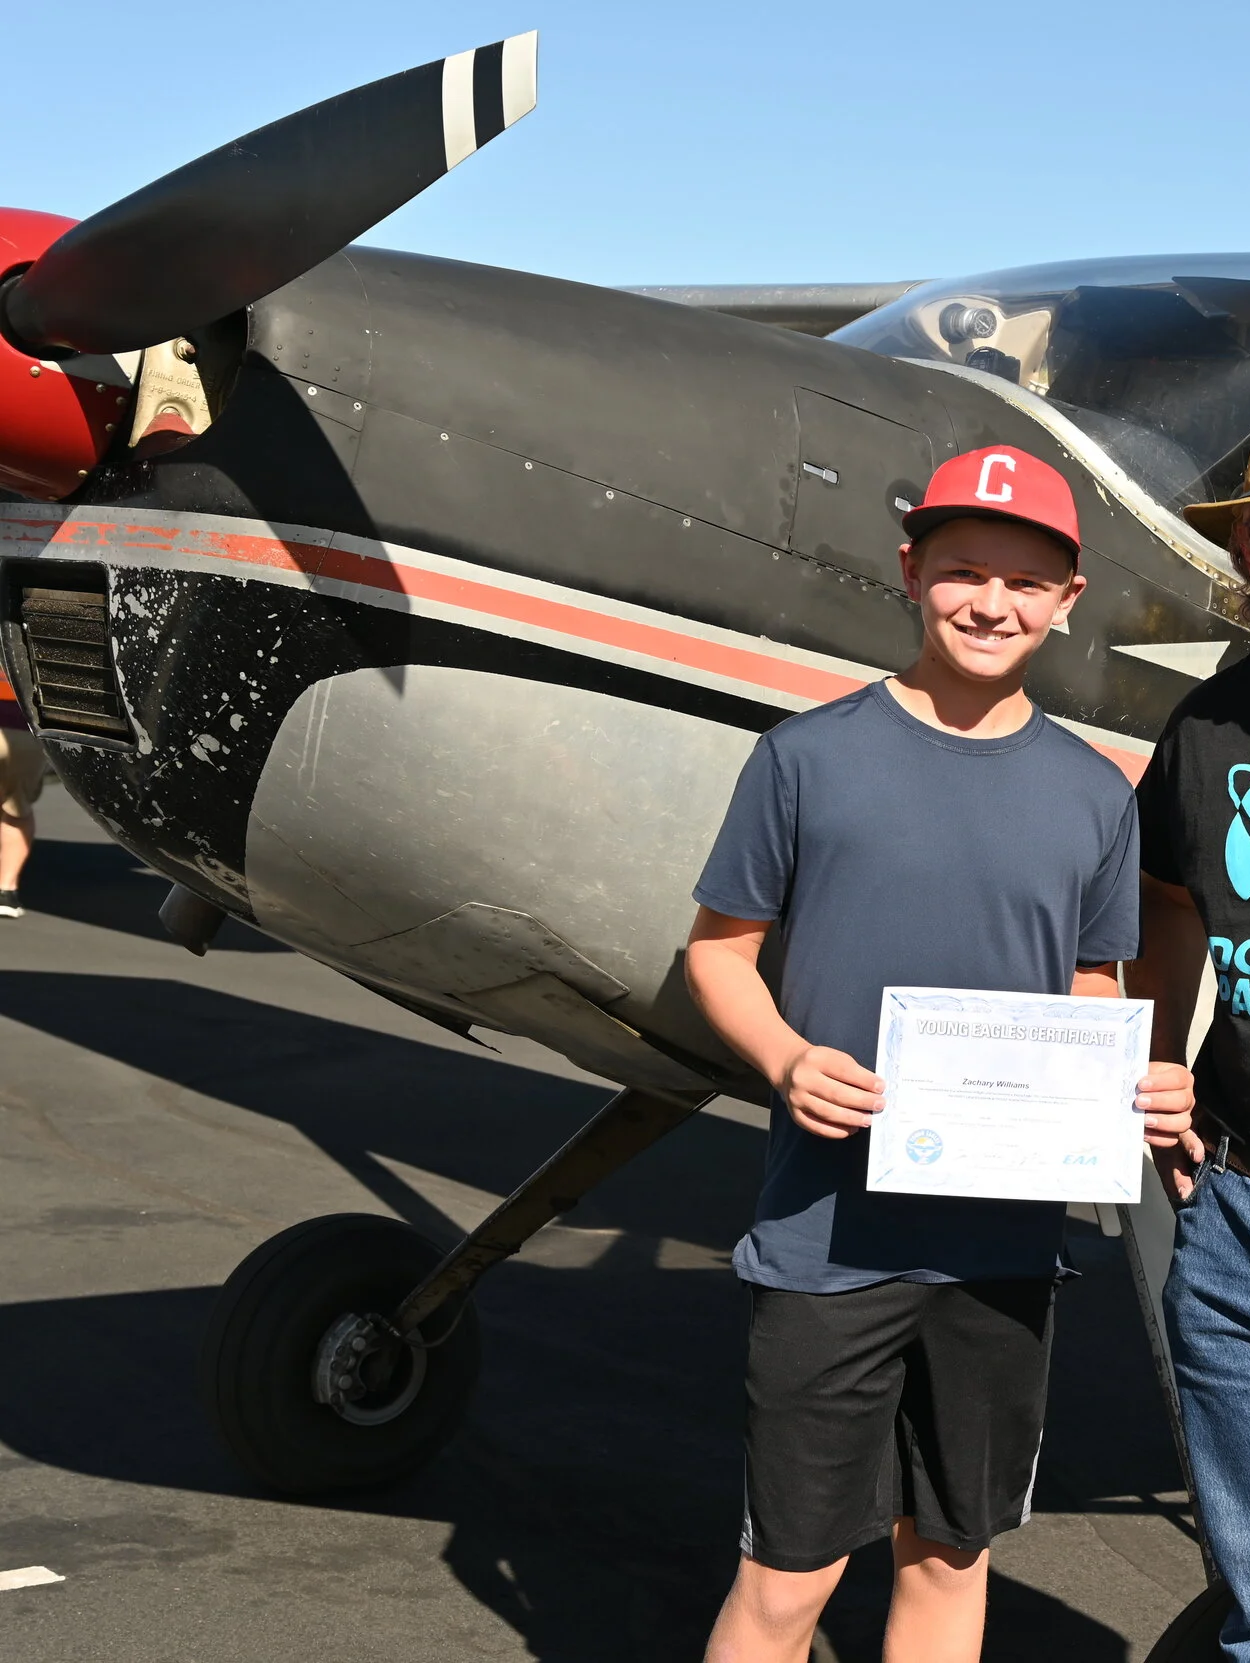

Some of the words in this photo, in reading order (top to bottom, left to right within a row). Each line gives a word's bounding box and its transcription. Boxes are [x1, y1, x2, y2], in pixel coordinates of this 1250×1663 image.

[975, 454, 1016, 503] C
[916, 1018, 969, 1037] YOUNG
[970, 1022, 1026, 1041] EAGLES
[1027, 1025, 1116, 1047] CERTIFICATE
[962, 1077, 995, 1089] Zachary
[996, 1079, 1030, 1090] Williams
[1062, 1154, 1098, 1167] EAA
